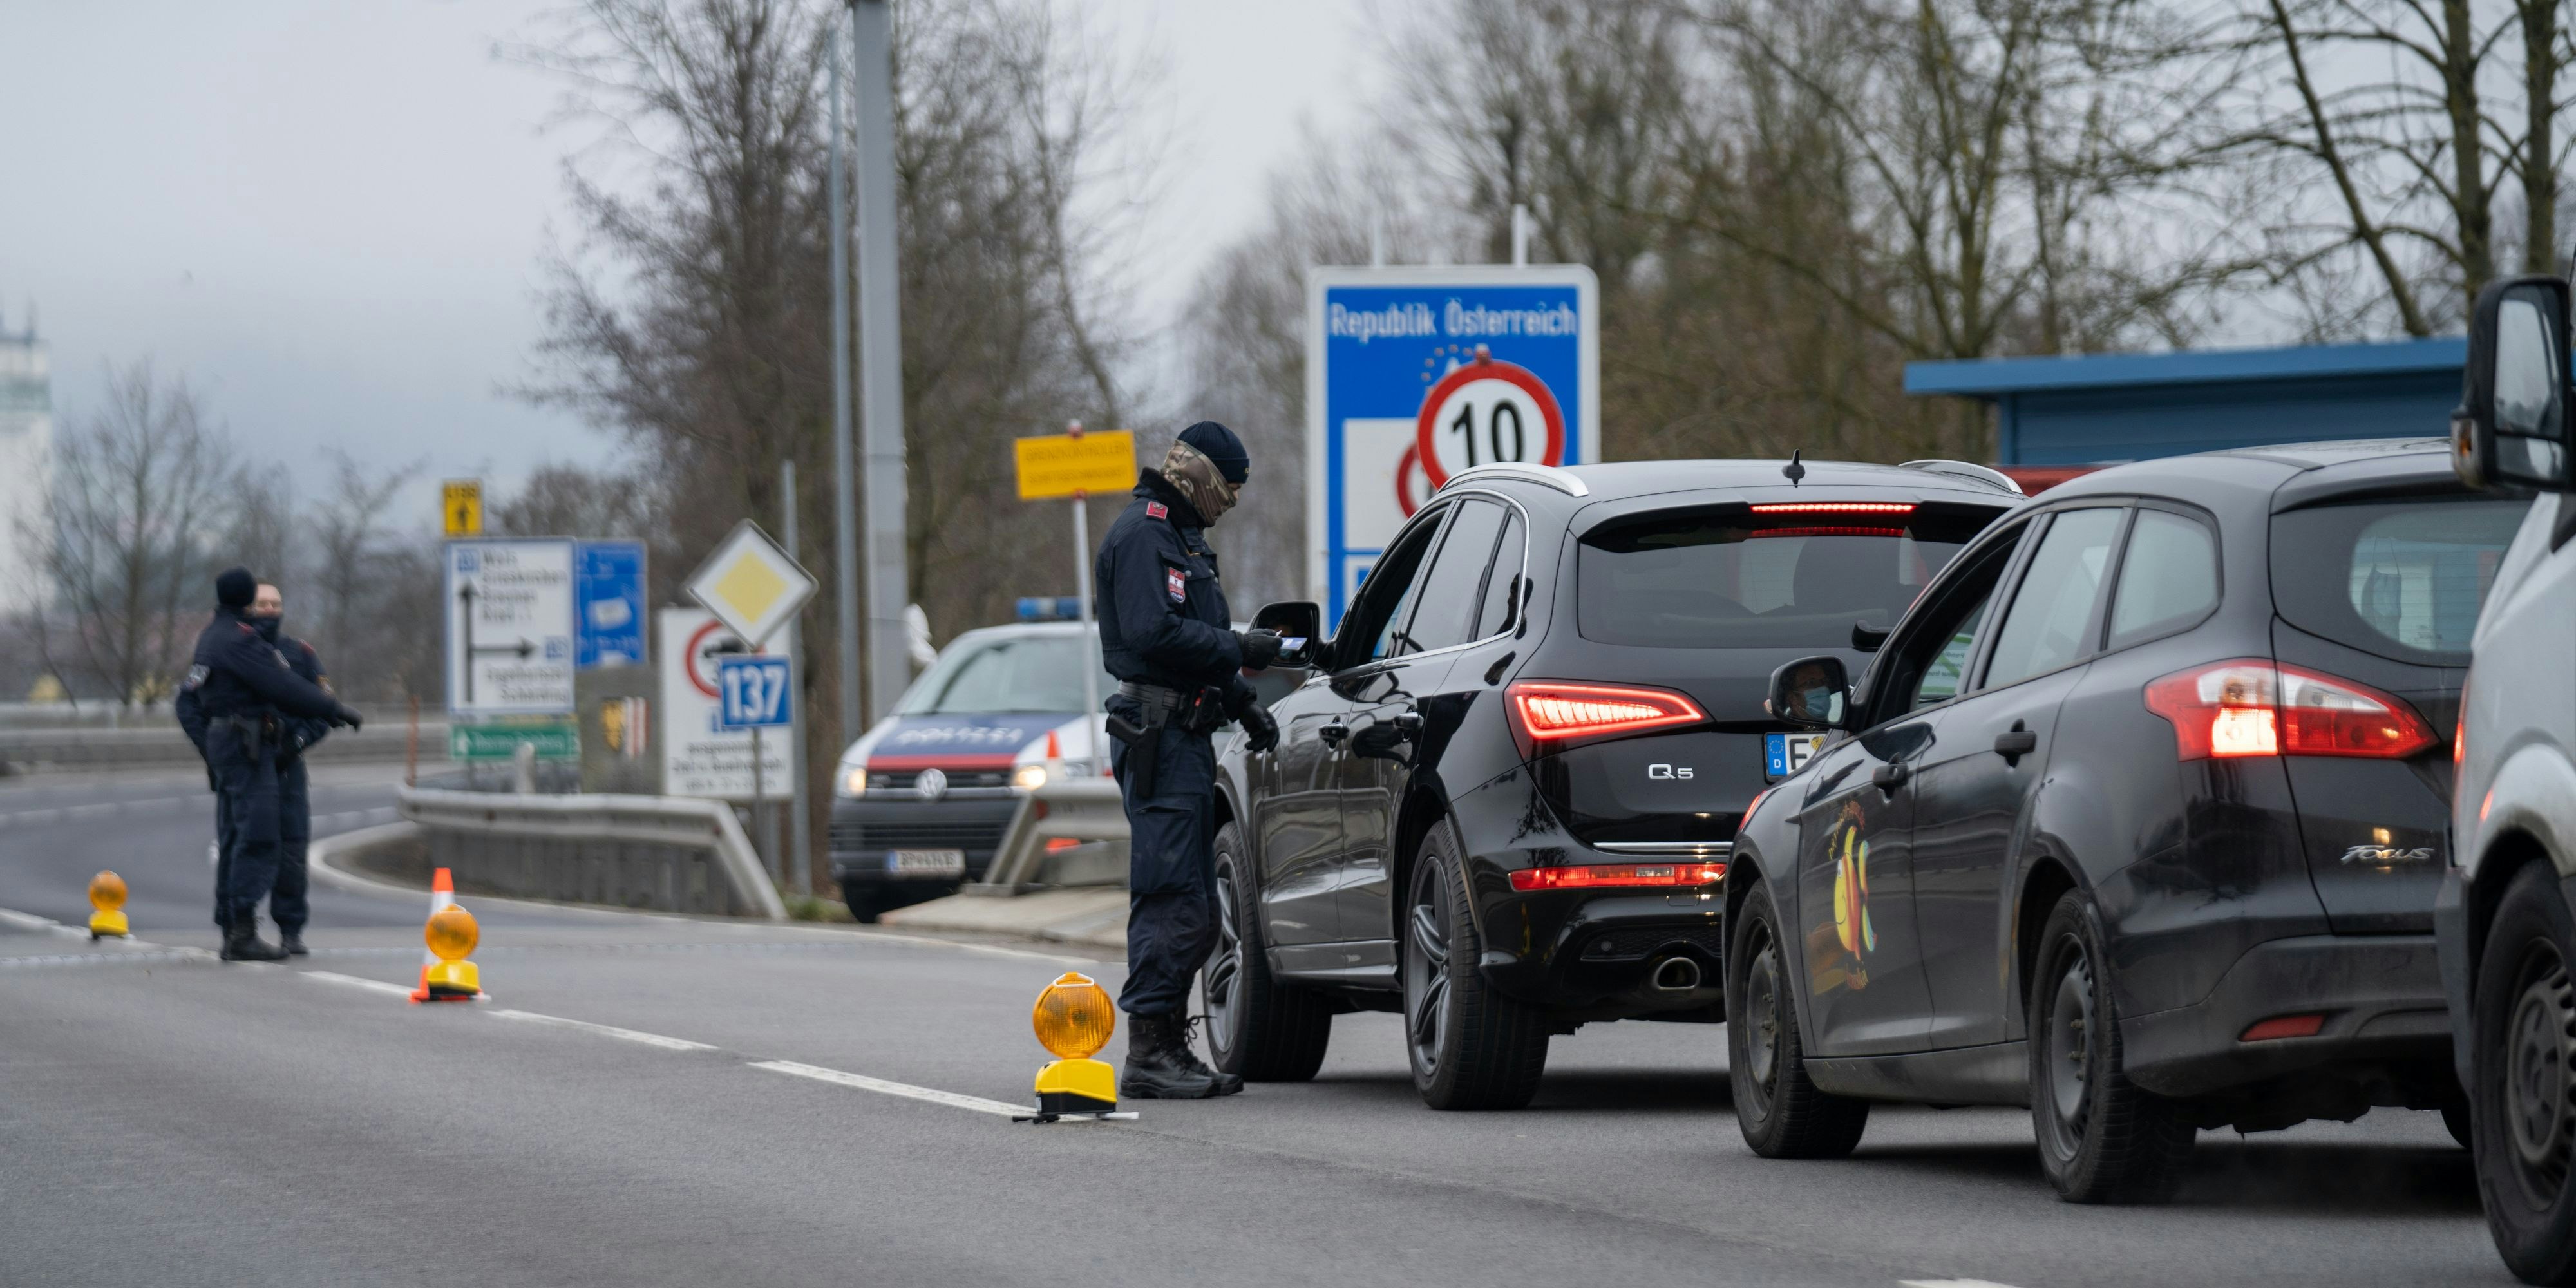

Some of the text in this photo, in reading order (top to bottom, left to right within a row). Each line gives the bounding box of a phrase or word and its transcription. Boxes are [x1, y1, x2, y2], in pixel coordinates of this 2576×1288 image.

[1330, 298, 1577, 344] Republik Österreich
[1451, 398, 1524, 467] 10
[724, 664, 786, 724] 137
[1648, 764, 1694, 779] Q5
[1774, 759, 1781, 768] D
[1790, 738, 1809, 770] F
